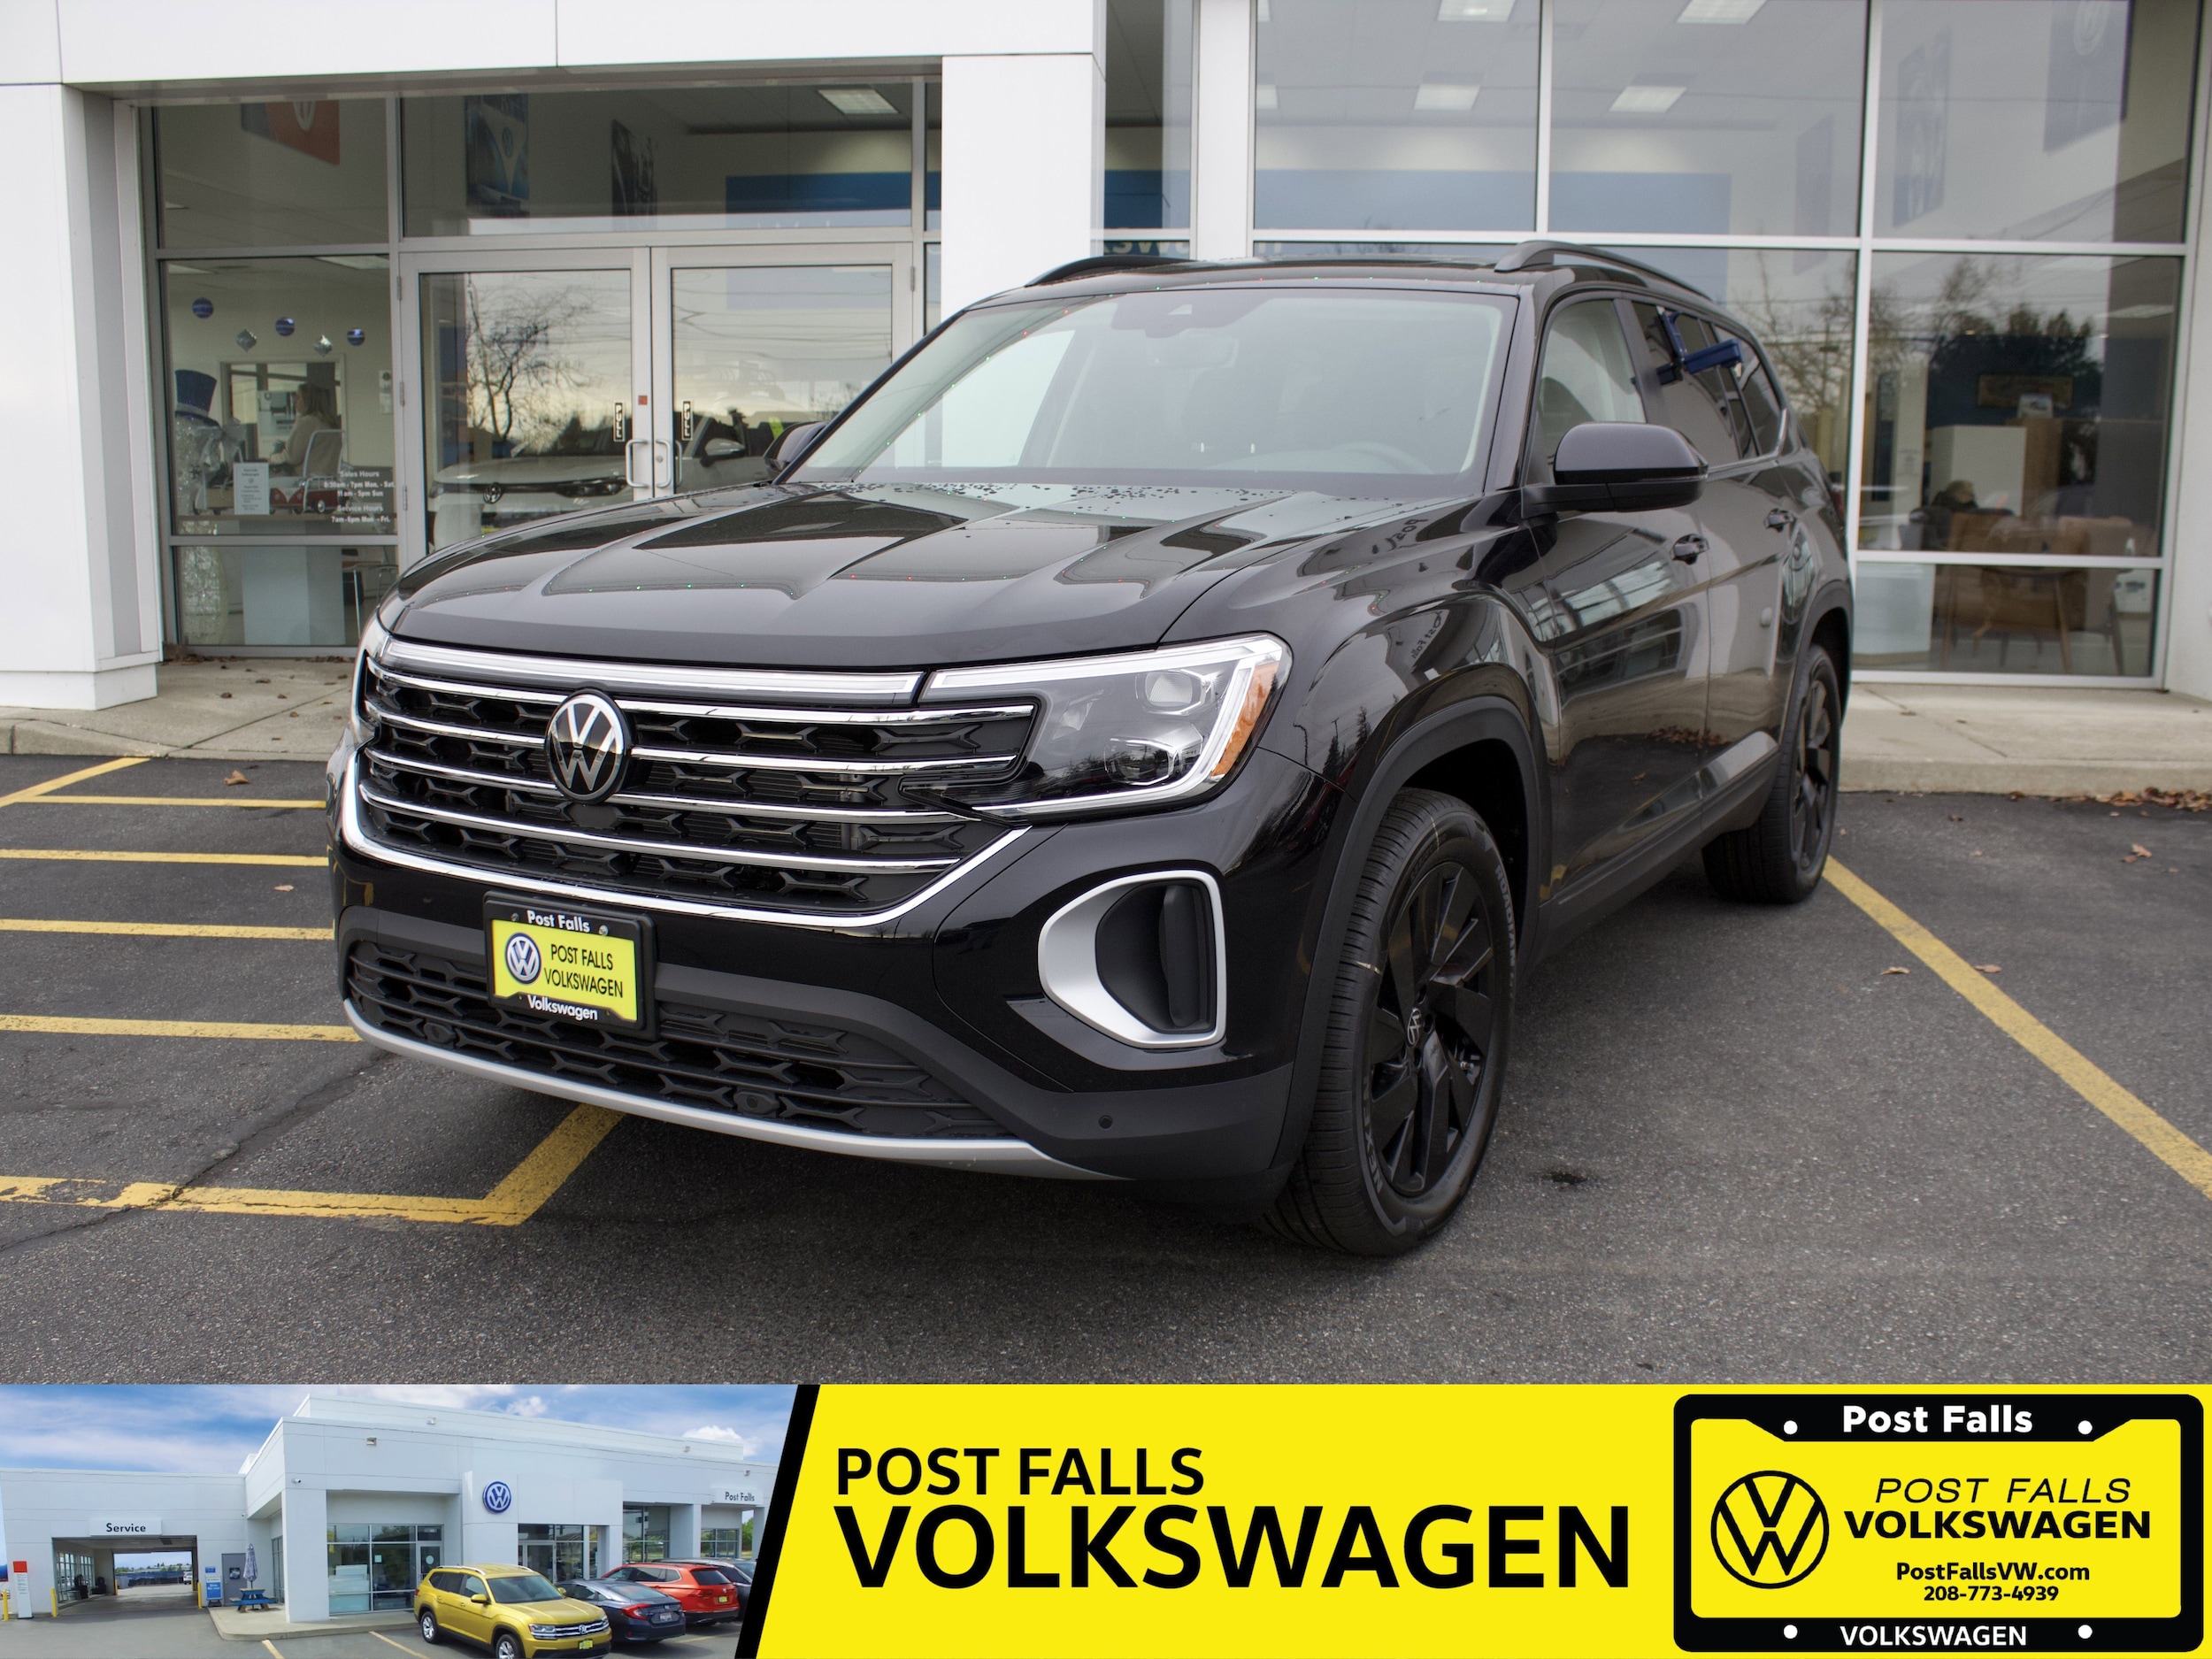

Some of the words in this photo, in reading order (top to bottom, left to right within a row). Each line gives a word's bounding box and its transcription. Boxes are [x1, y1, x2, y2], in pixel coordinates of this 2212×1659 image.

[547, 694, 625, 801] VW
[526, 910, 555, 928] Post
[557, 914, 591, 933] Falls
[506, 933, 541, 984] VW
[550, 943, 578, 964] POST
[581, 949, 613, 971] FALLS
[543, 967, 624, 999] VOLKSWAGEN
[527, 995, 598, 1021] Volkswagen
